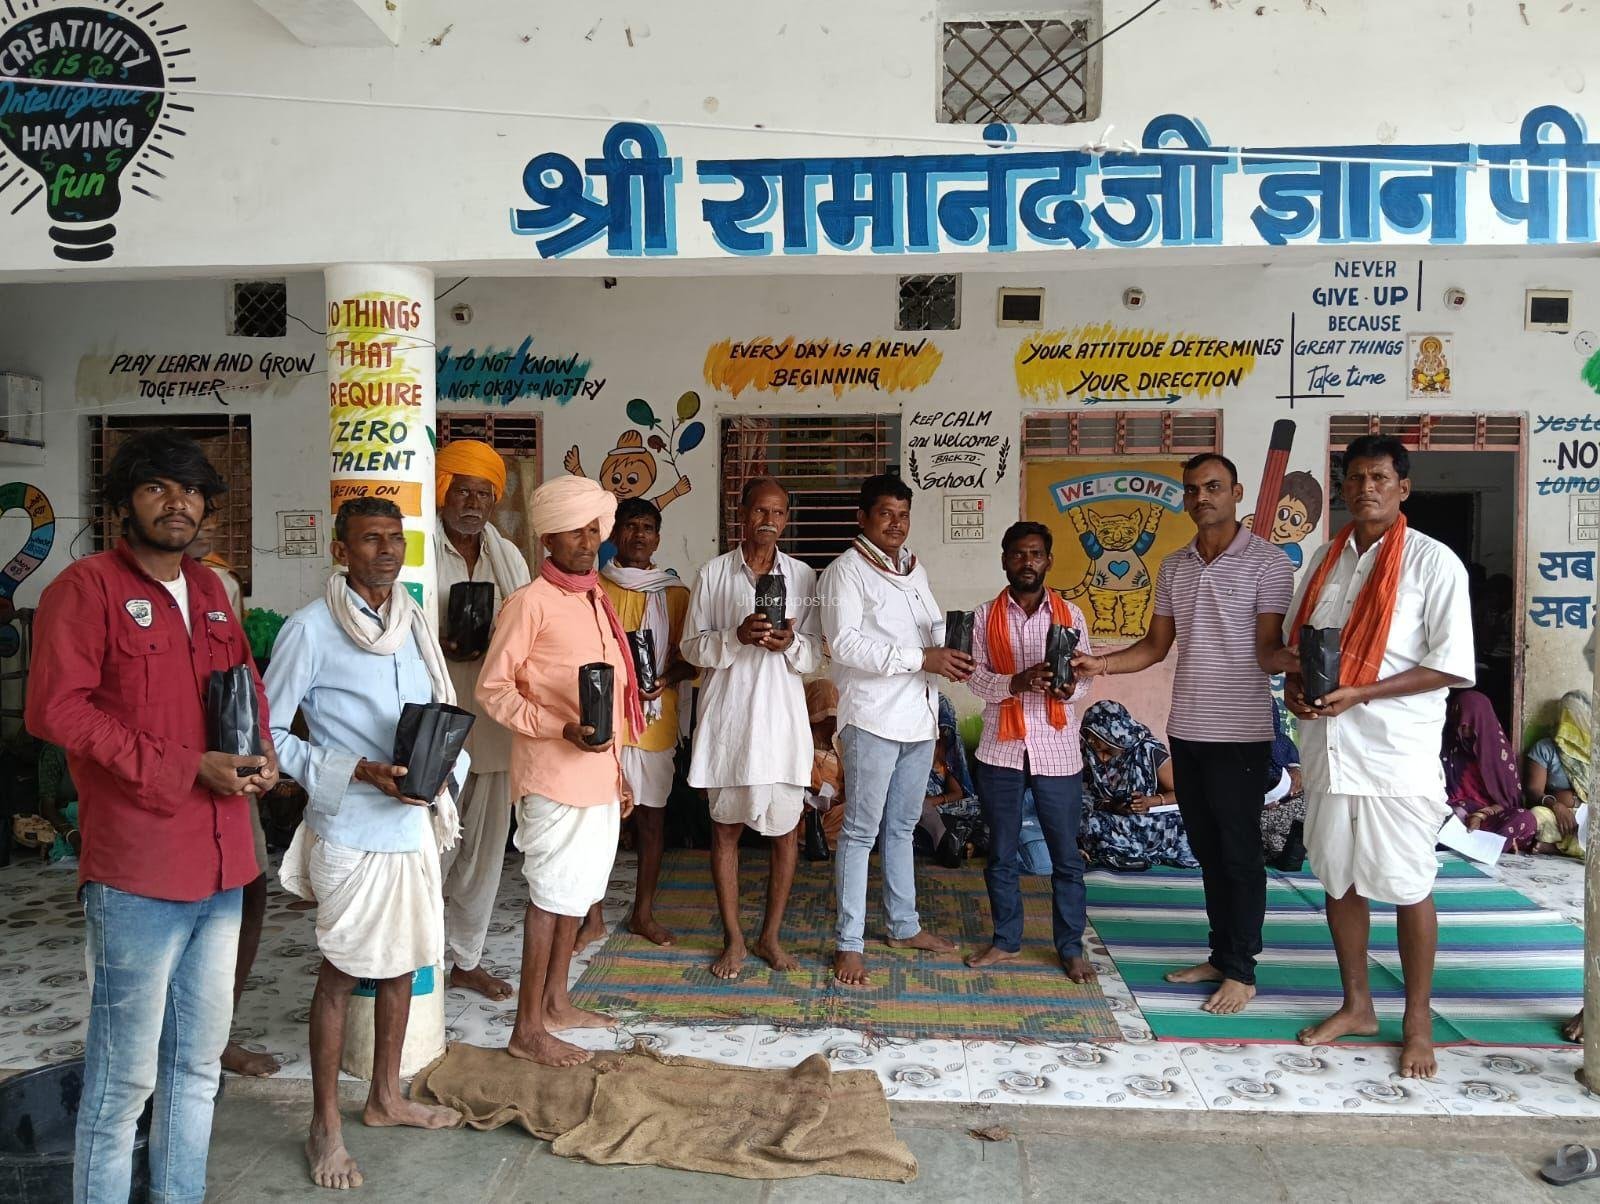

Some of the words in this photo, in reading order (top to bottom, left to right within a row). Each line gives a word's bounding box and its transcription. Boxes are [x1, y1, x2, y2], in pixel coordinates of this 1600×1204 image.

[0, 19, 151, 76] CREATIVITY
[53, 51, 82, 76] is
[22, 118, 134, 151] HAVING
[50, 164, 105, 206] fun
[510, 121, 682, 258] श्री
[1334, 260, 1397, 278] NEVER
[1312, 287, 1360, 307] GIVE
[1374, 286, 1409, 306] UP
[343, 299, 421, 331] THINGS
[1328, 314, 1401, 332] BECAUSE
[336, 341, 398, 368] THAT
[729, 343, 789, 360] EVERY
[794, 343, 830, 359] DAY
[833, 343, 853, 358] IS
[855, 341, 874, 358] A
[876, 337, 927, 359] NEW
[1022, 343, 1073, 365] YOUR
[1075, 340, 1164, 360] ATTITUDE
[1168, 338, 1285, 359] DETERMINES
[1294, 339, 1347, 356] GREAT
[1348, 339, 1405, 356] THINGS
[109, 354, 156, 376] PLAY
[156, 353, 212, 374] LEARN
[213, 353, 254, 373] AND
[259, 352, 316, 380] GROW
[455, 356, 476, 372] TO
[480, 355, 516, 373] NOT
[519, 352, 580, 376] KNOW
[448, 380, 481, 400] NOT
[483, 378, 525, 401] OKAY
[768, 367, 881, 391] BEGINNING
[1066, 370, 1130, 395] YOUR
[1136, 367, 1244, 392] DIRECTION
[1307, 364, 1343, 394] Take
[1345, 364, 1387, 388] time
[330, 381, 422, 409] REQUIRE
[941, 410, 993, 428] CALM
[336, 420, 408, 444] ZERO
[933, 432, 1000, 448] Welcome
[332, 450, 416, 473] TALENT
[922, 467, 988, 491] School
[333, 485, 369, 498] BEING
[374, 485, 400, 496] ON
[1537, 551, 1596, 582] सब
[1528, 596, 1592, 629] सब
